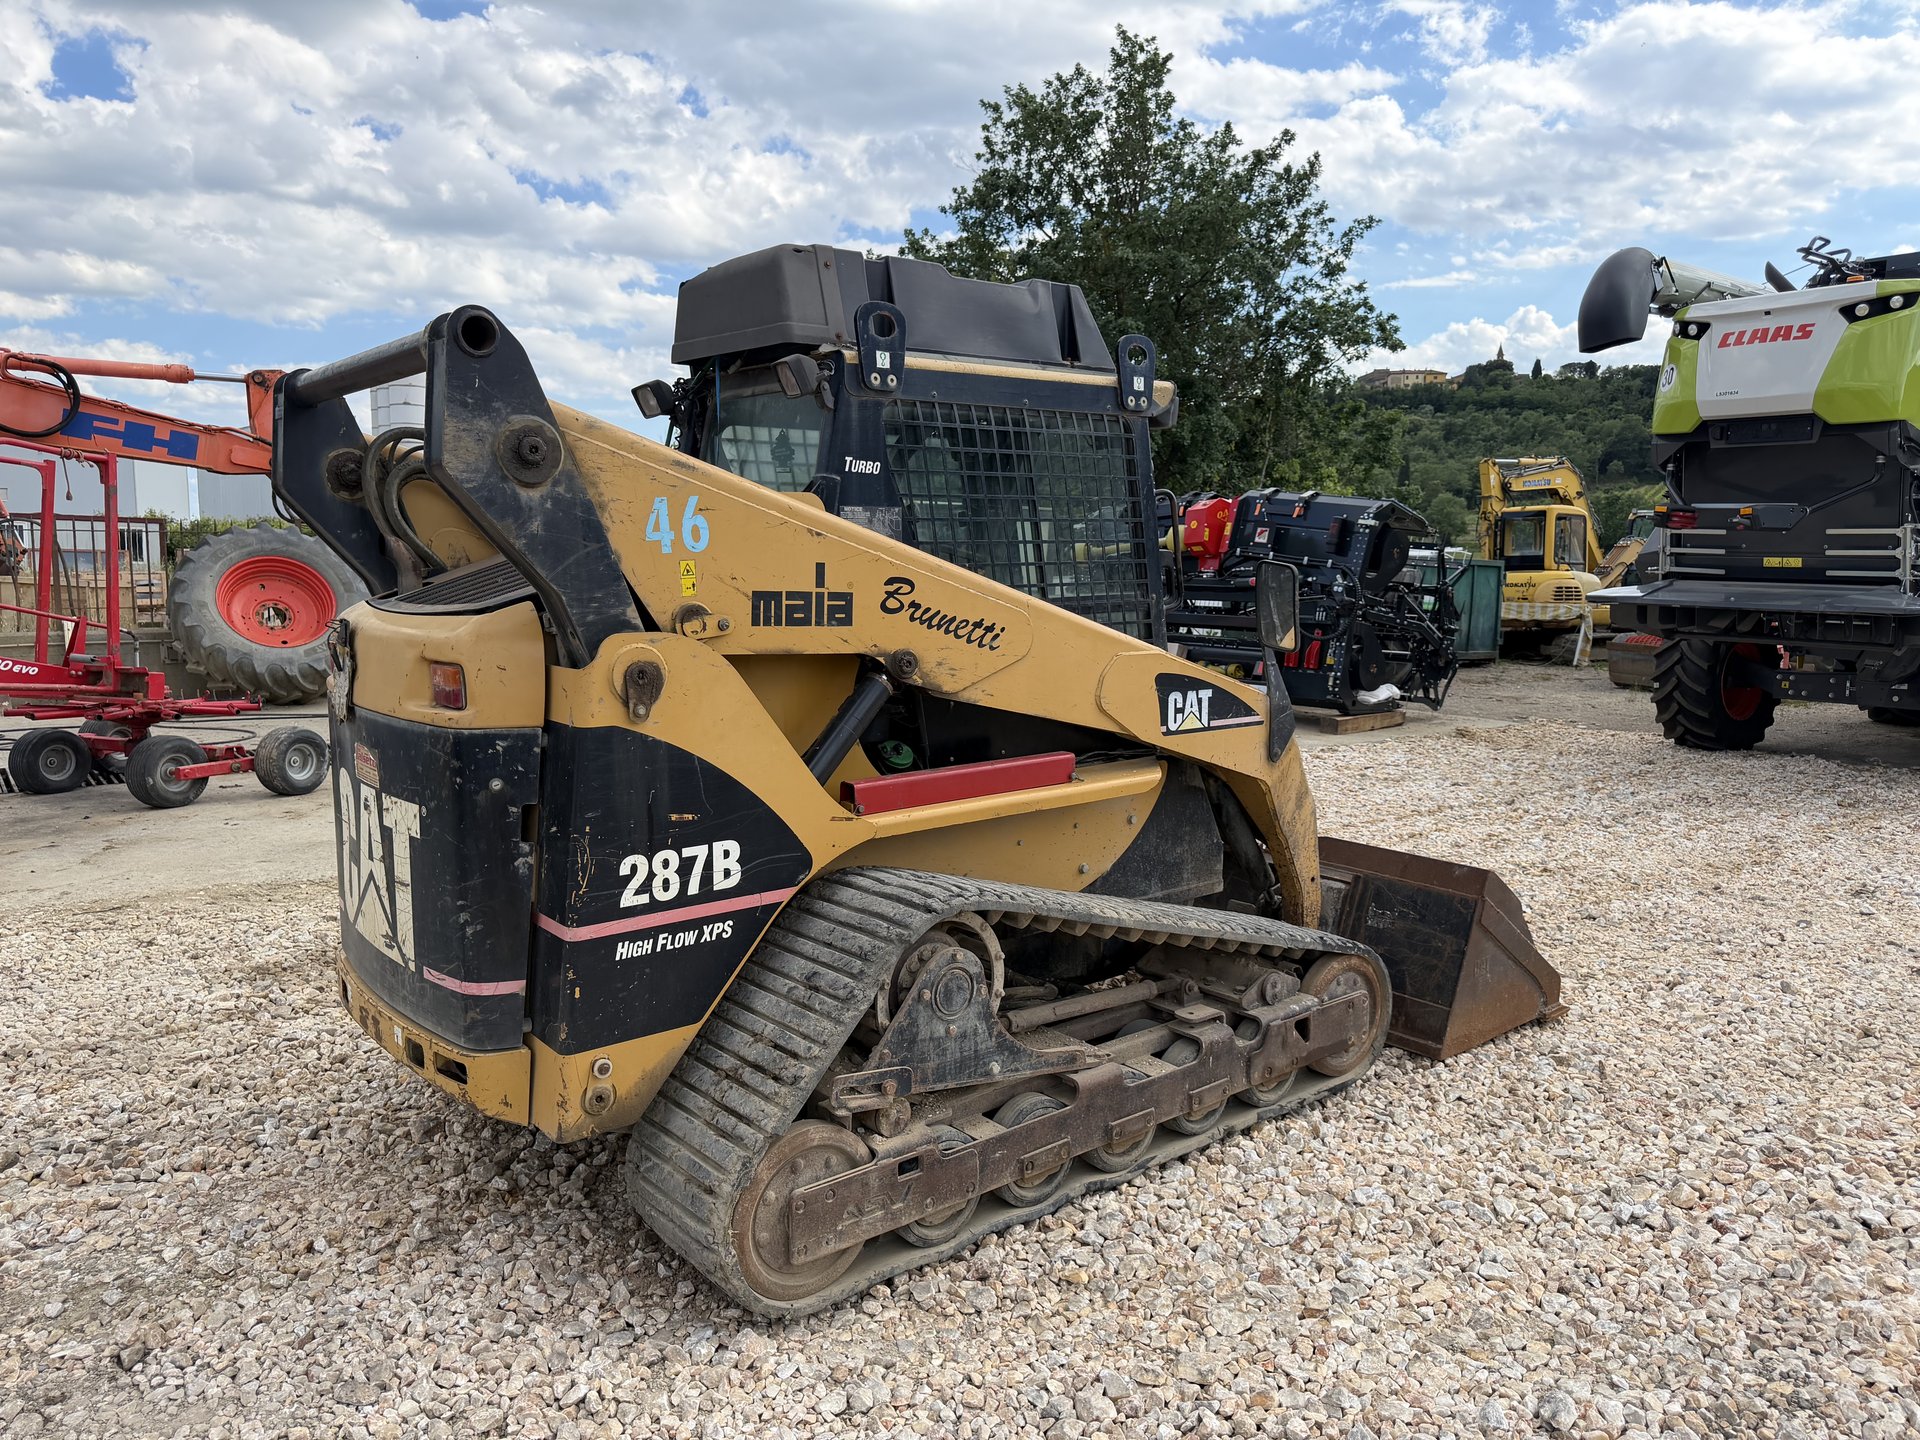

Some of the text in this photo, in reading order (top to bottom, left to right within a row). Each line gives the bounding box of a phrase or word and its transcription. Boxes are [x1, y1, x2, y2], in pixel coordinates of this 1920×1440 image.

[1717, 323, 1816, 349] CLAAS
[1661, 366, 1674, 388] 30
[844, 456, 881, 475] TURBO
[1522, 478, 1552, 488] KOMATSU
[645, 496, 710, 554] 46
[752, 562, 854, 627] maia
[879, 576, 1006, 651] Brunetti
[0, 659, 13, 671] 0
[1167, 688, 1213, 731] CAT
[339, 767, 421, 973] CAT
[618, 839, 742, 909] 287B
[700, 919, 734, 943] XPS
